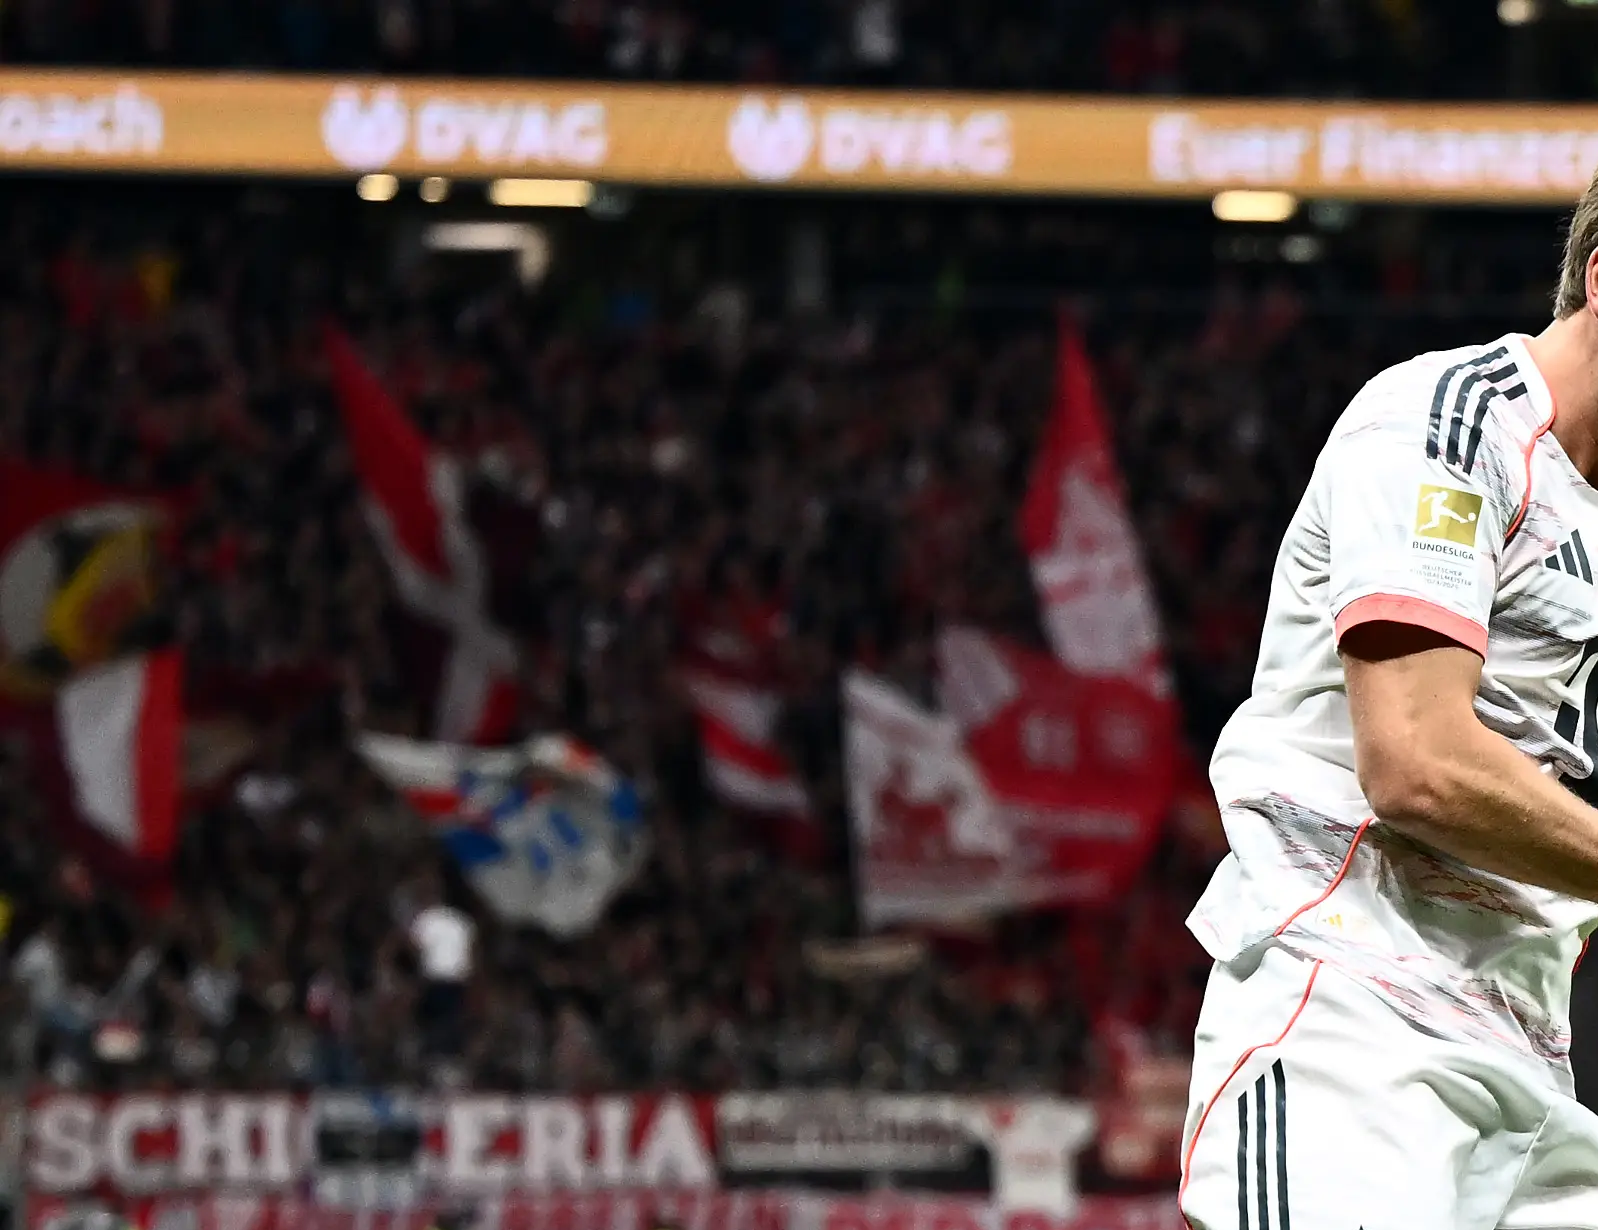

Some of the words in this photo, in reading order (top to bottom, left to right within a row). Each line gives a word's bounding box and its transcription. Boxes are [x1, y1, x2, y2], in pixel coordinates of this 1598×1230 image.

[415, 101, 607, 164] DVAG
[823, 109, 1011, 175] DVAG
[1412, 541, 1475, 561] BUNDESLIGA
[30, 1097, 718, 1191] SCHIERIA
